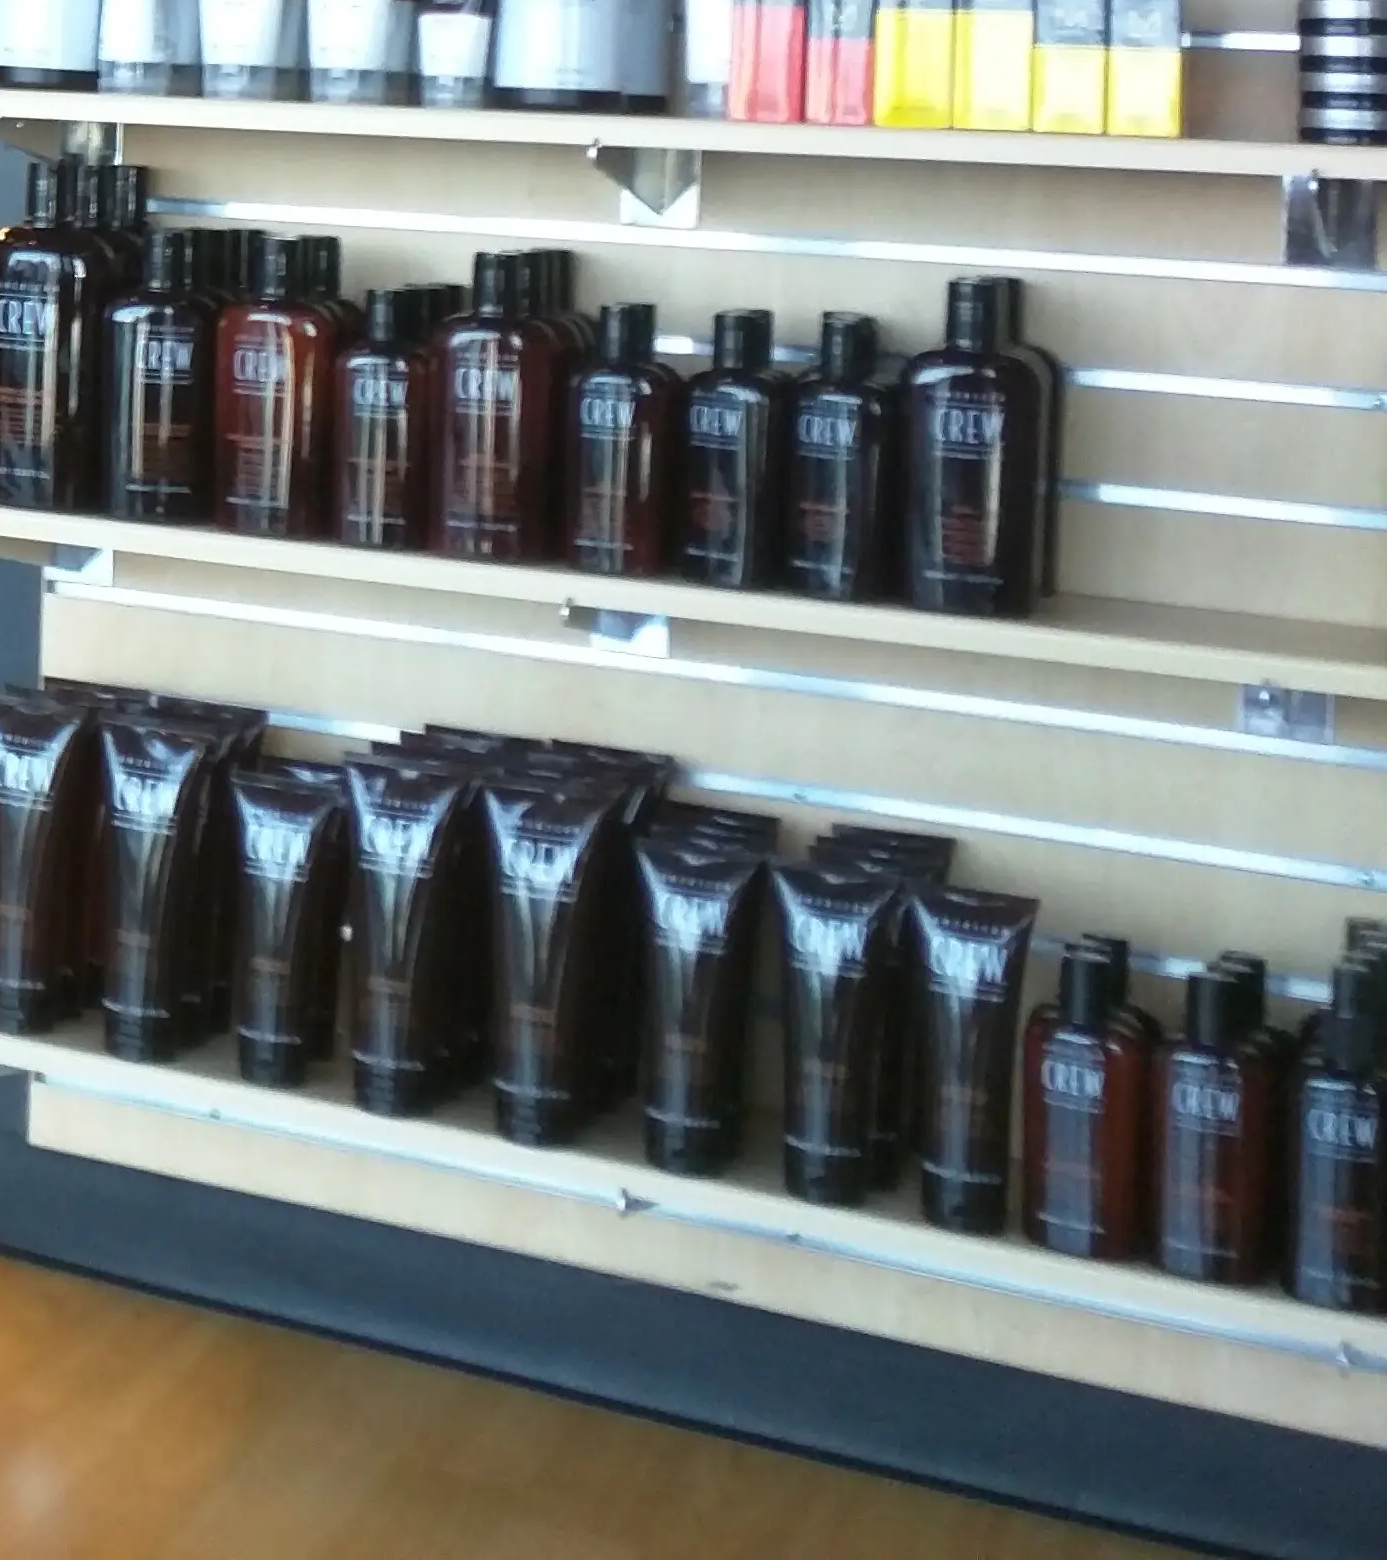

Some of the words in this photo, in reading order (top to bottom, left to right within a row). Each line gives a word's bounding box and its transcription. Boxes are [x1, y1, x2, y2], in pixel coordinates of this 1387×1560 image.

[354, 378, 408, 406] CREW
[580, 397, 635, 428] CREW
[690, 404, 743, 437] CREW
[935, 408, 1005, 443] CREW
[797, 414, 856, 447] CREW
[1041, 1059, 1104, 1097] CREW
[1174, 1083, 1240, 1121] CREW
[1308, 1109, 1377, 1149] CREW
